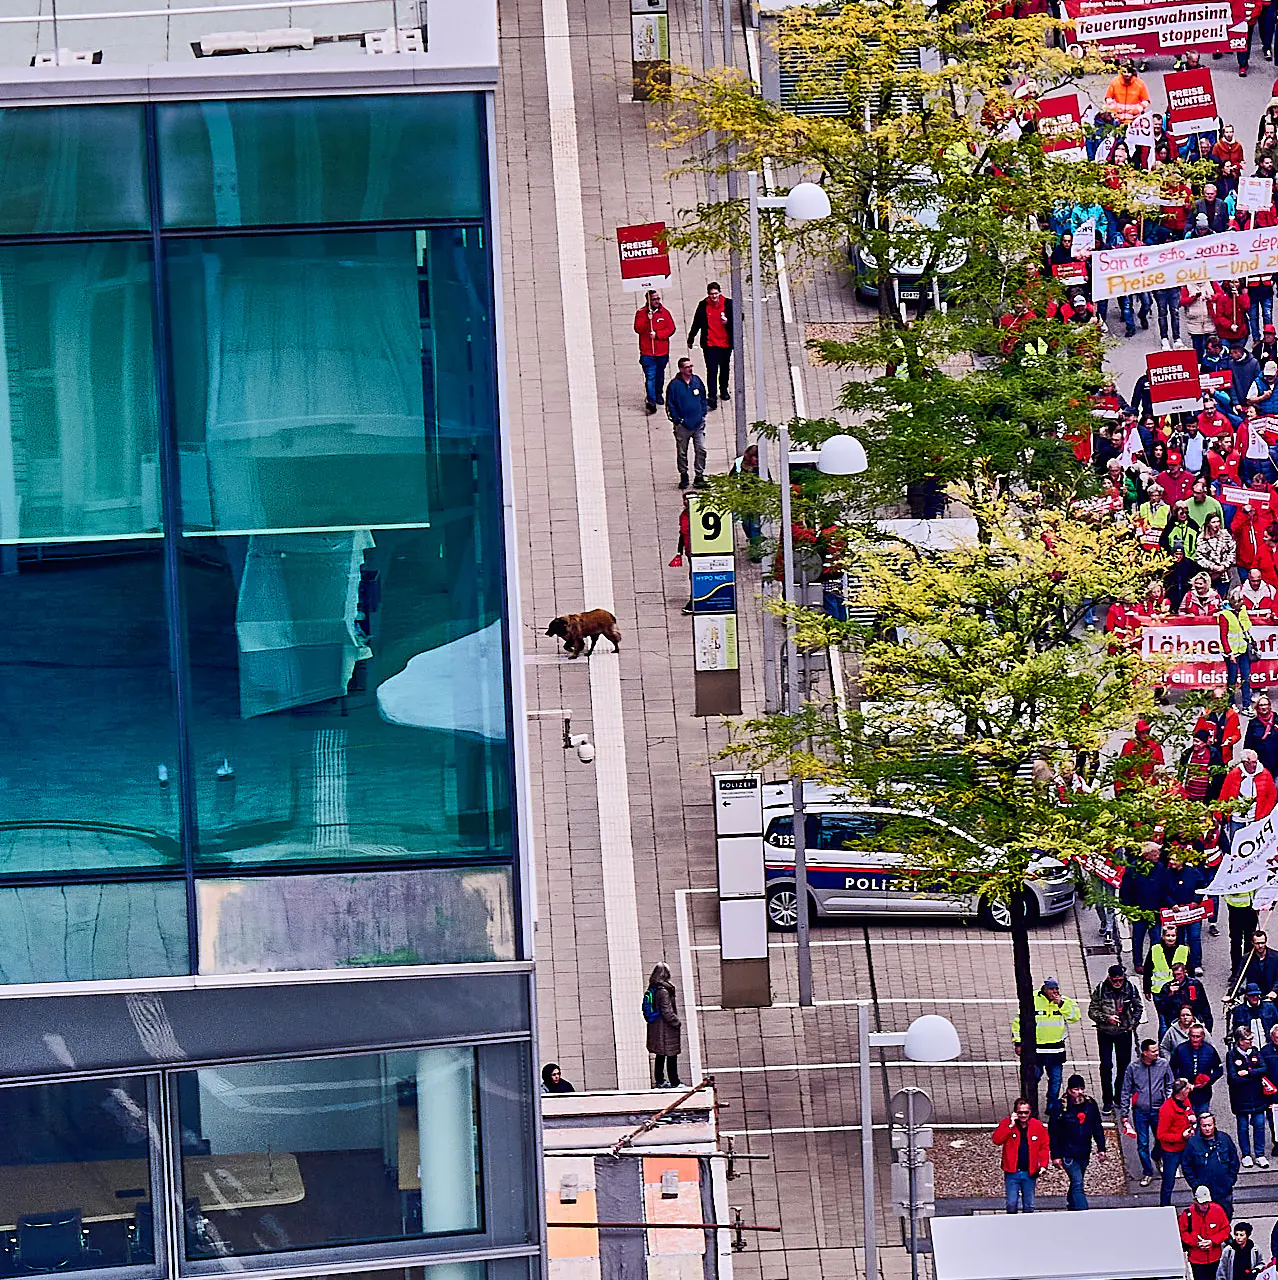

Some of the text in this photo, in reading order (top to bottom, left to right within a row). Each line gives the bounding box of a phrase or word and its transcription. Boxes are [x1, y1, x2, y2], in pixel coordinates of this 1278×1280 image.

[1079, 6, 1227, 34] Teuerungswahnsinn
[1161, 25, 1223, 44] stoppen!
[1230, 38, 1246, 48] SPÖ
[1168, 86, 1204, 100] PREISE
[1171, 93, 1212, 108] RUNTER
[621, 240, 652, 252] PREISE
[622, 247, 659, 260] RUNTER
[1100, 252, 1129, 272] San
[1134, 251, 1149, 266] de
[1158, 247, 1186, 263] scho
[1107, 271, 1166, 294] Preise
[1150, 365, 1183, 377] PREISE
[1151, 372, 1190, 385] RUNTER
[702, 512, 721, 540] 9
[1149, 634, 1220, 655] Löhne
[1172, 670, 1194, 683] ein
[721, 782, 752, 790] POLIZEI
[845, 877, 919, 892] POLIZEI
